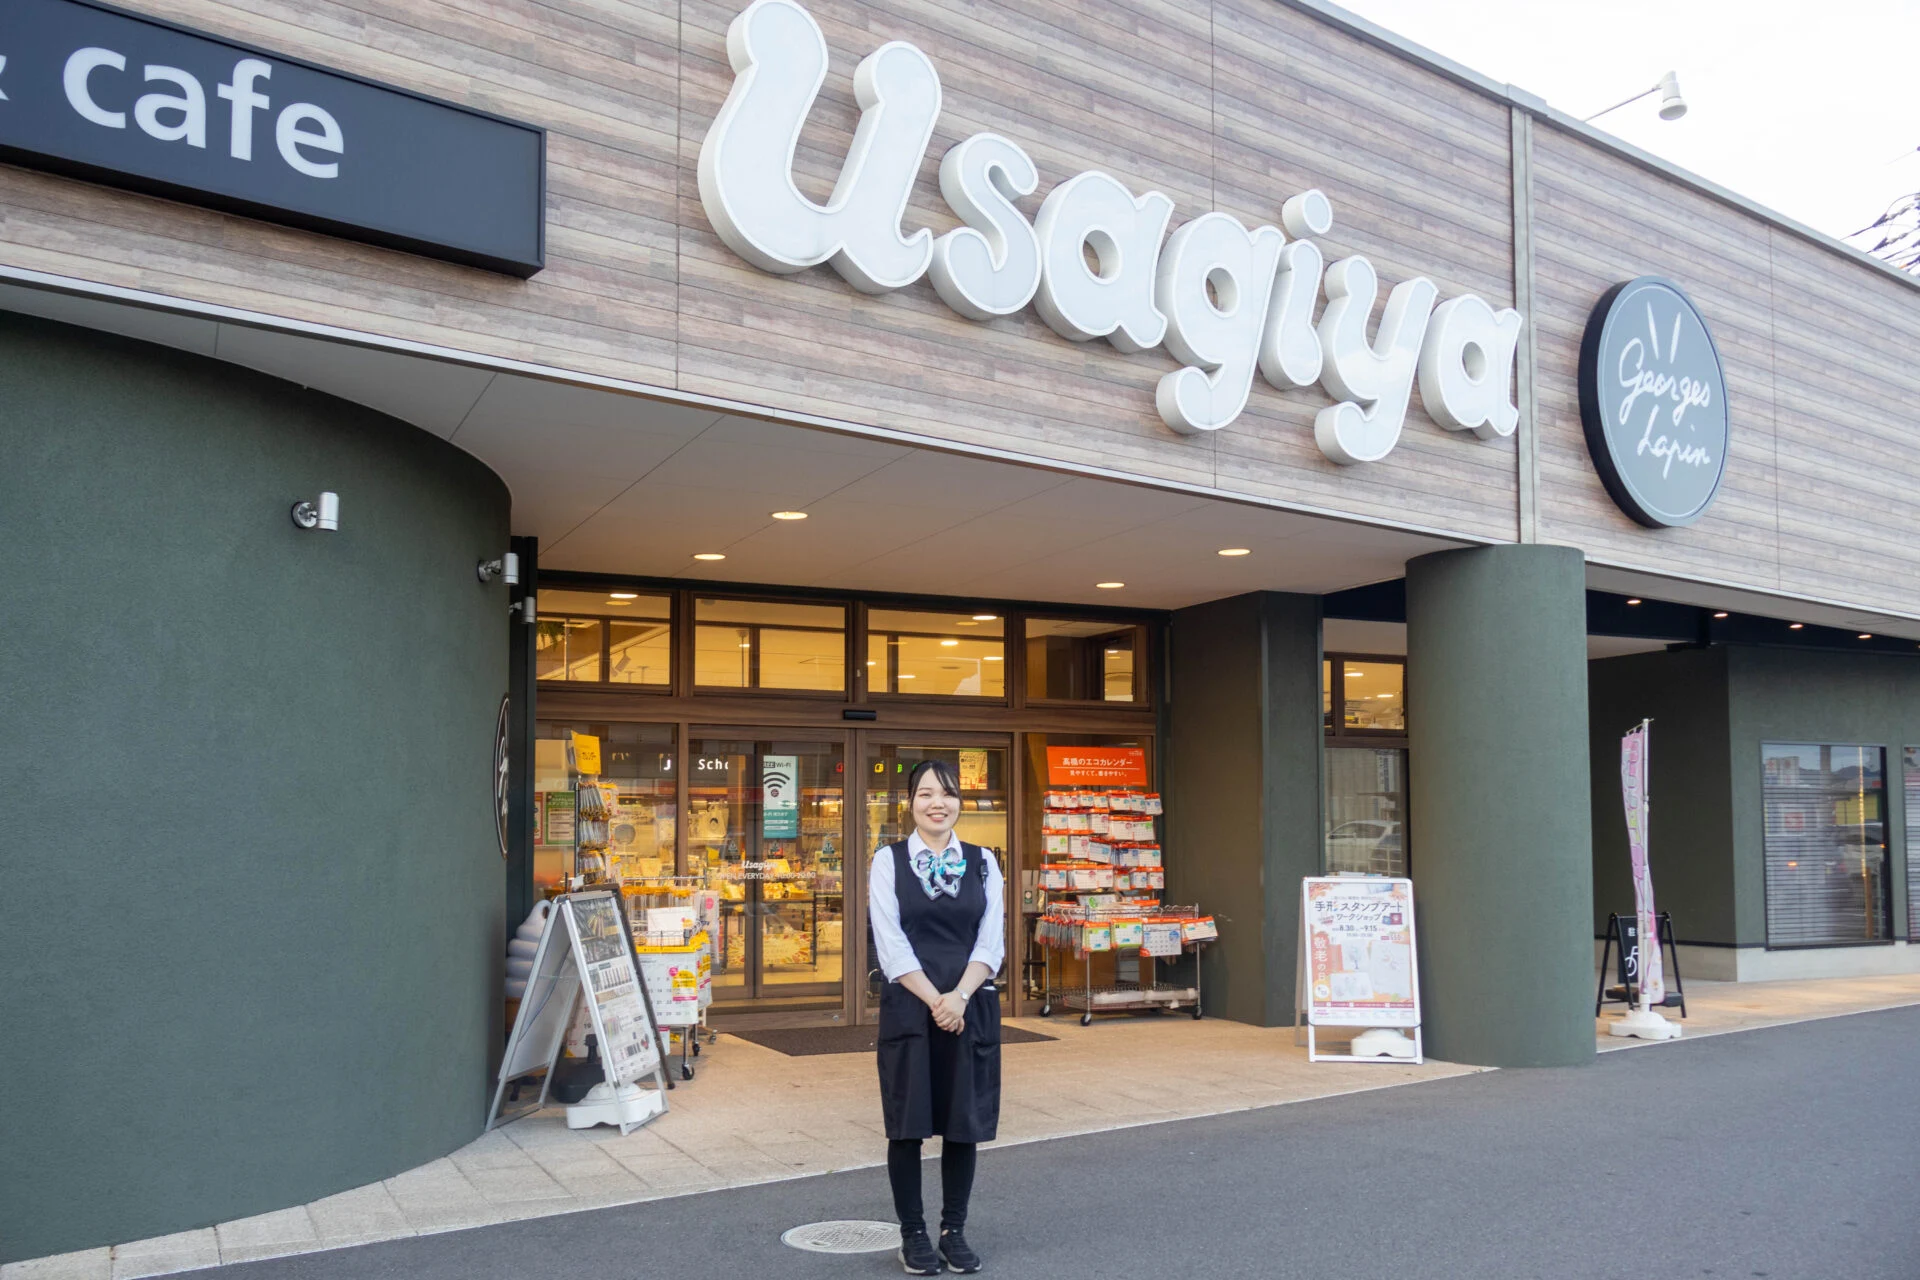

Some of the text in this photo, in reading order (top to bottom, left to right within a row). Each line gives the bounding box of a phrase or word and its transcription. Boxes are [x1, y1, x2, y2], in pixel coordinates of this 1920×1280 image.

[63, 47, 344, 178] cafe
[698, 0, 1522, 464] Usagiya
[1618, 336, 1711, 426] Georges
[1636, 403, 1711, 480] Lapin
[1062, 757, 1133, 766] 高橋のエコカレンダー
[738, 872, 773, 880] EVERYDAY
